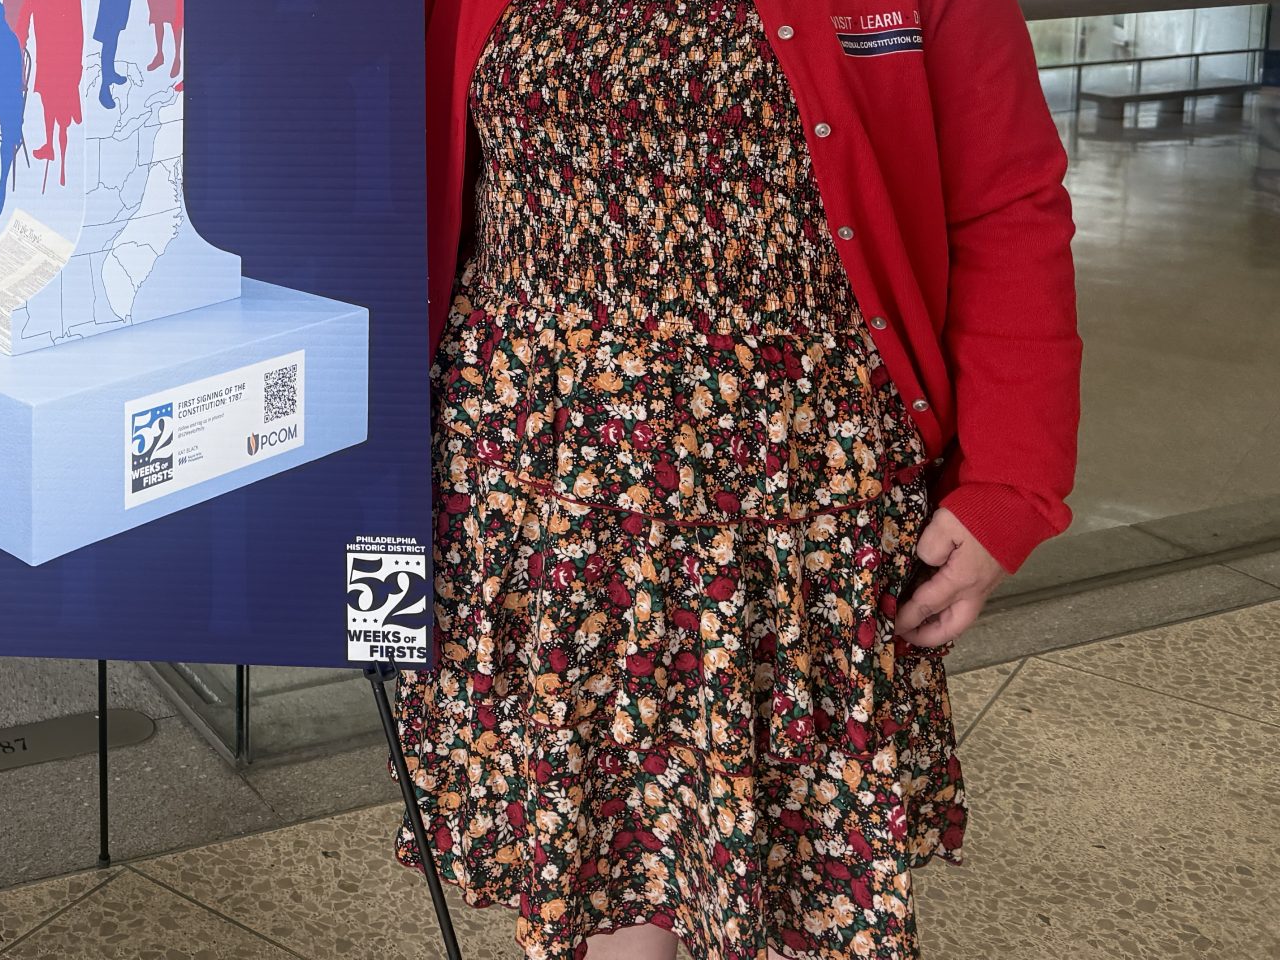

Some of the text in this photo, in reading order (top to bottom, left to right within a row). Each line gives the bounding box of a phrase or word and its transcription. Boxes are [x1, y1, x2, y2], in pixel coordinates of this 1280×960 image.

[830, 15, 852, 30] VISIT
[860, 11, 903, 30] LEARN
[860, 35, 912, 49] CONSTITUTION
[178, 382, 246, 410] FIRST SIGNING OF THE
[229, 392, 243, 403] 1787
[132, 410, 173, 463] 52
[261, 424, 298, 450] PCOM
[131, 461, 169, 480] WEEKS OF
[142, 468, 173, 488] FIRSTS
[347, 544, 426, 553] HISTORIC DISTRICT
[356, 536, 417, 545] PHILADELPHIA
[347, 557, 426, 629] 52
[347, 629, 417, 644] WEEKS OF
[370, 645, 427, 659] FIRSTS
